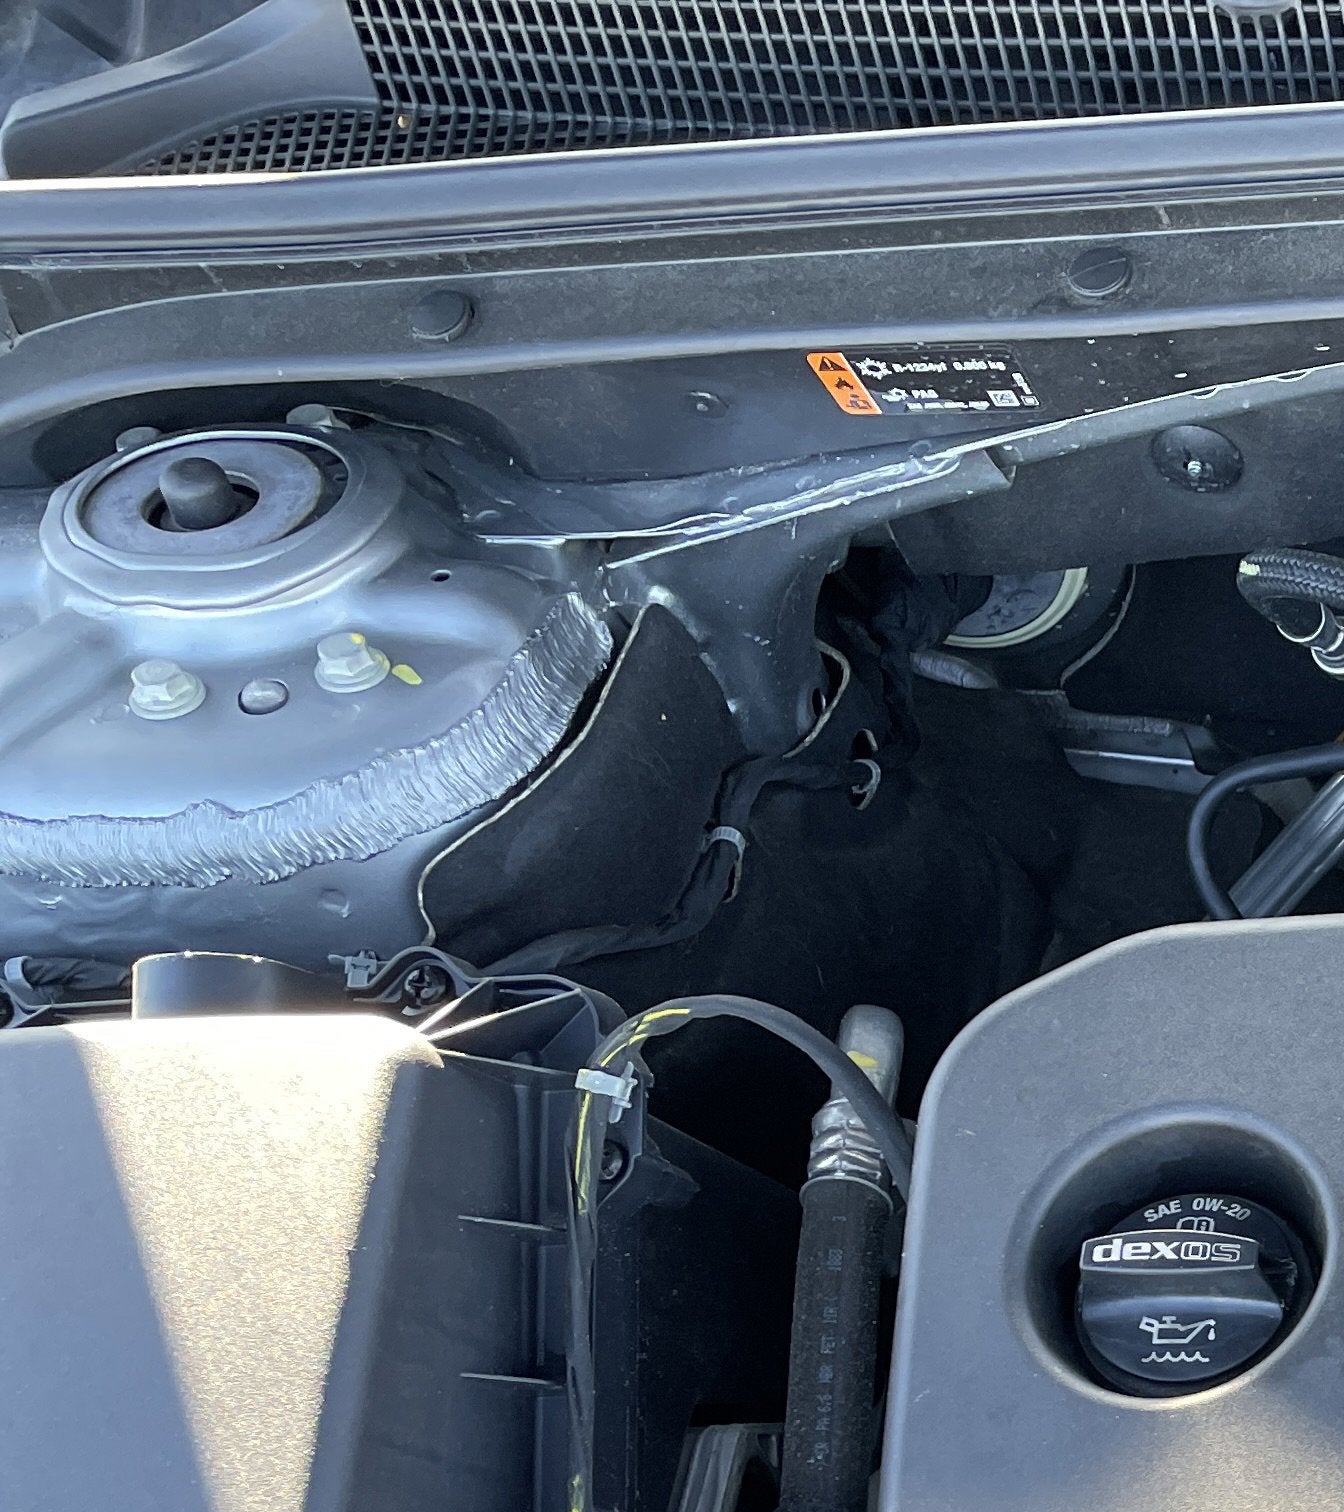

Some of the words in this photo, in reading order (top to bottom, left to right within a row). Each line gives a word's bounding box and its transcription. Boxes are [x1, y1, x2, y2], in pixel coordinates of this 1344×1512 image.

[1143, 1199, 1182, 1223] SAE
[1192, 1197, 1251, 1221] 0W-20
[1092, 1238, 1241, 1263] dexos
